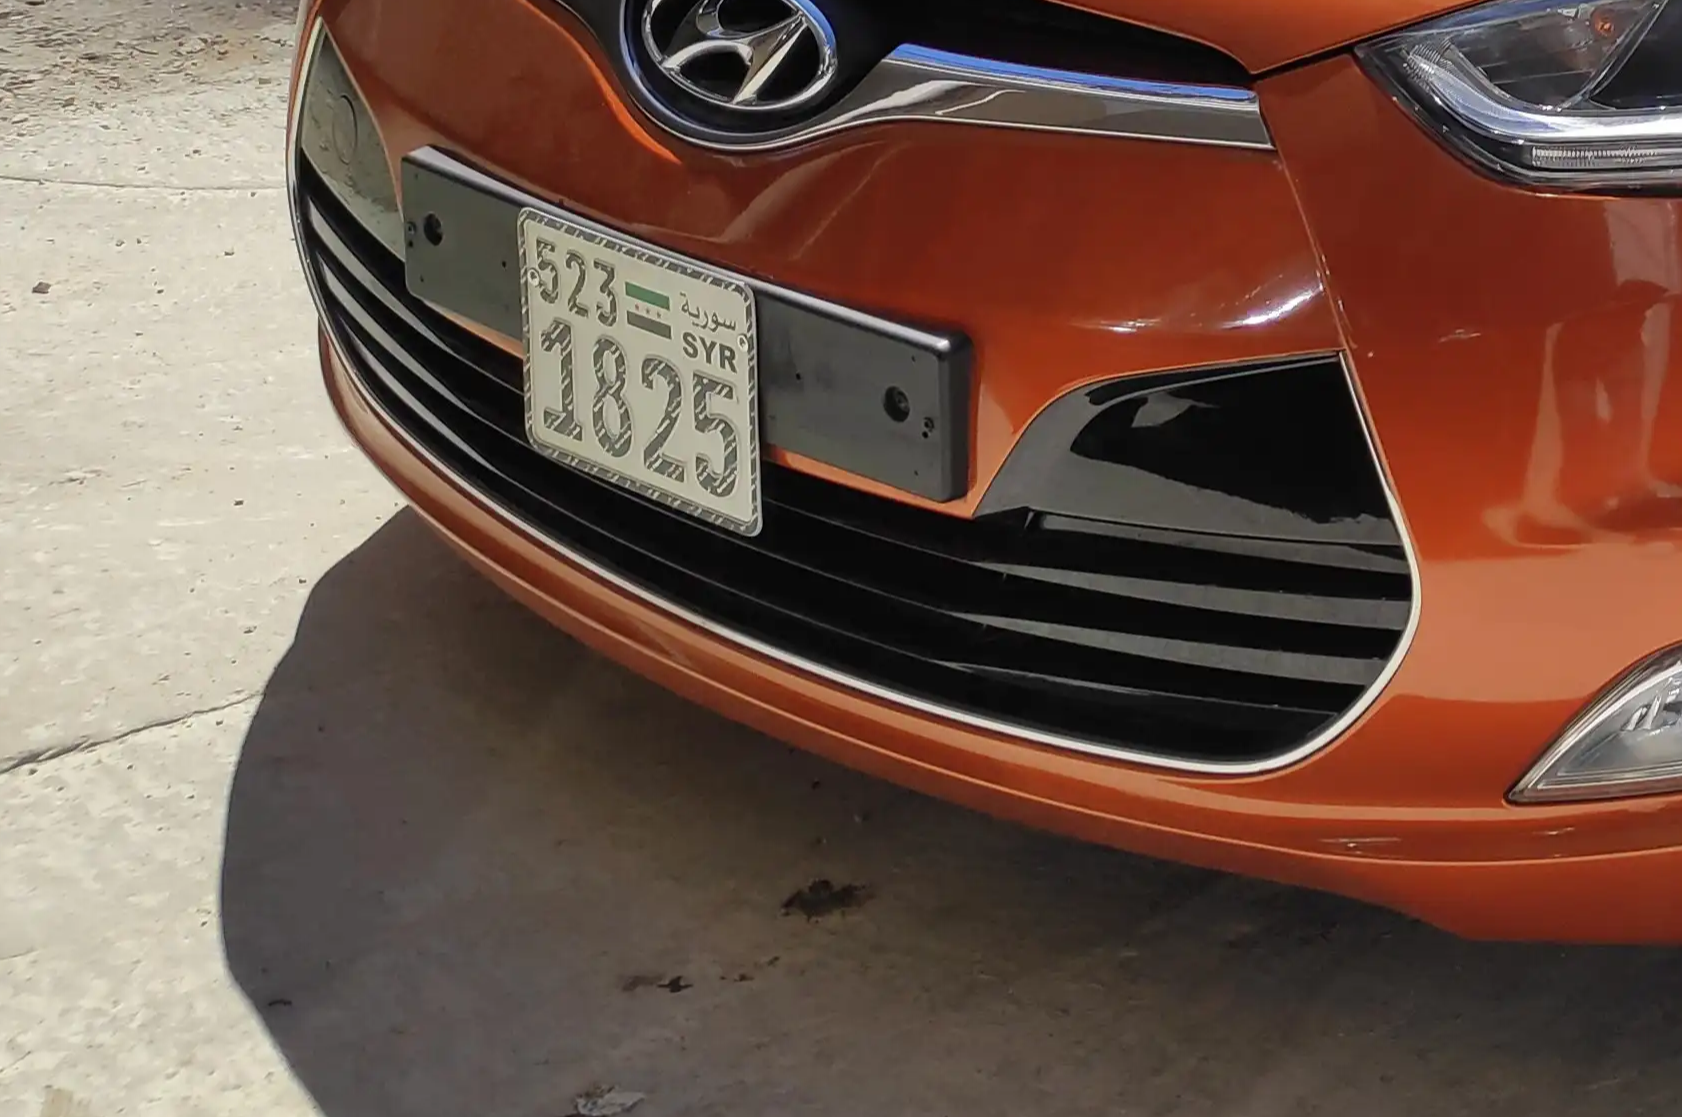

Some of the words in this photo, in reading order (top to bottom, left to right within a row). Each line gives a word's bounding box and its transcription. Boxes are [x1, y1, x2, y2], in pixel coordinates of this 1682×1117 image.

[535, 237, 619, 327] 523
[679, 291, 736, 332] سورية
[682, 331, 738, 374] SYR
[540, 318, 739, 498] 1825
